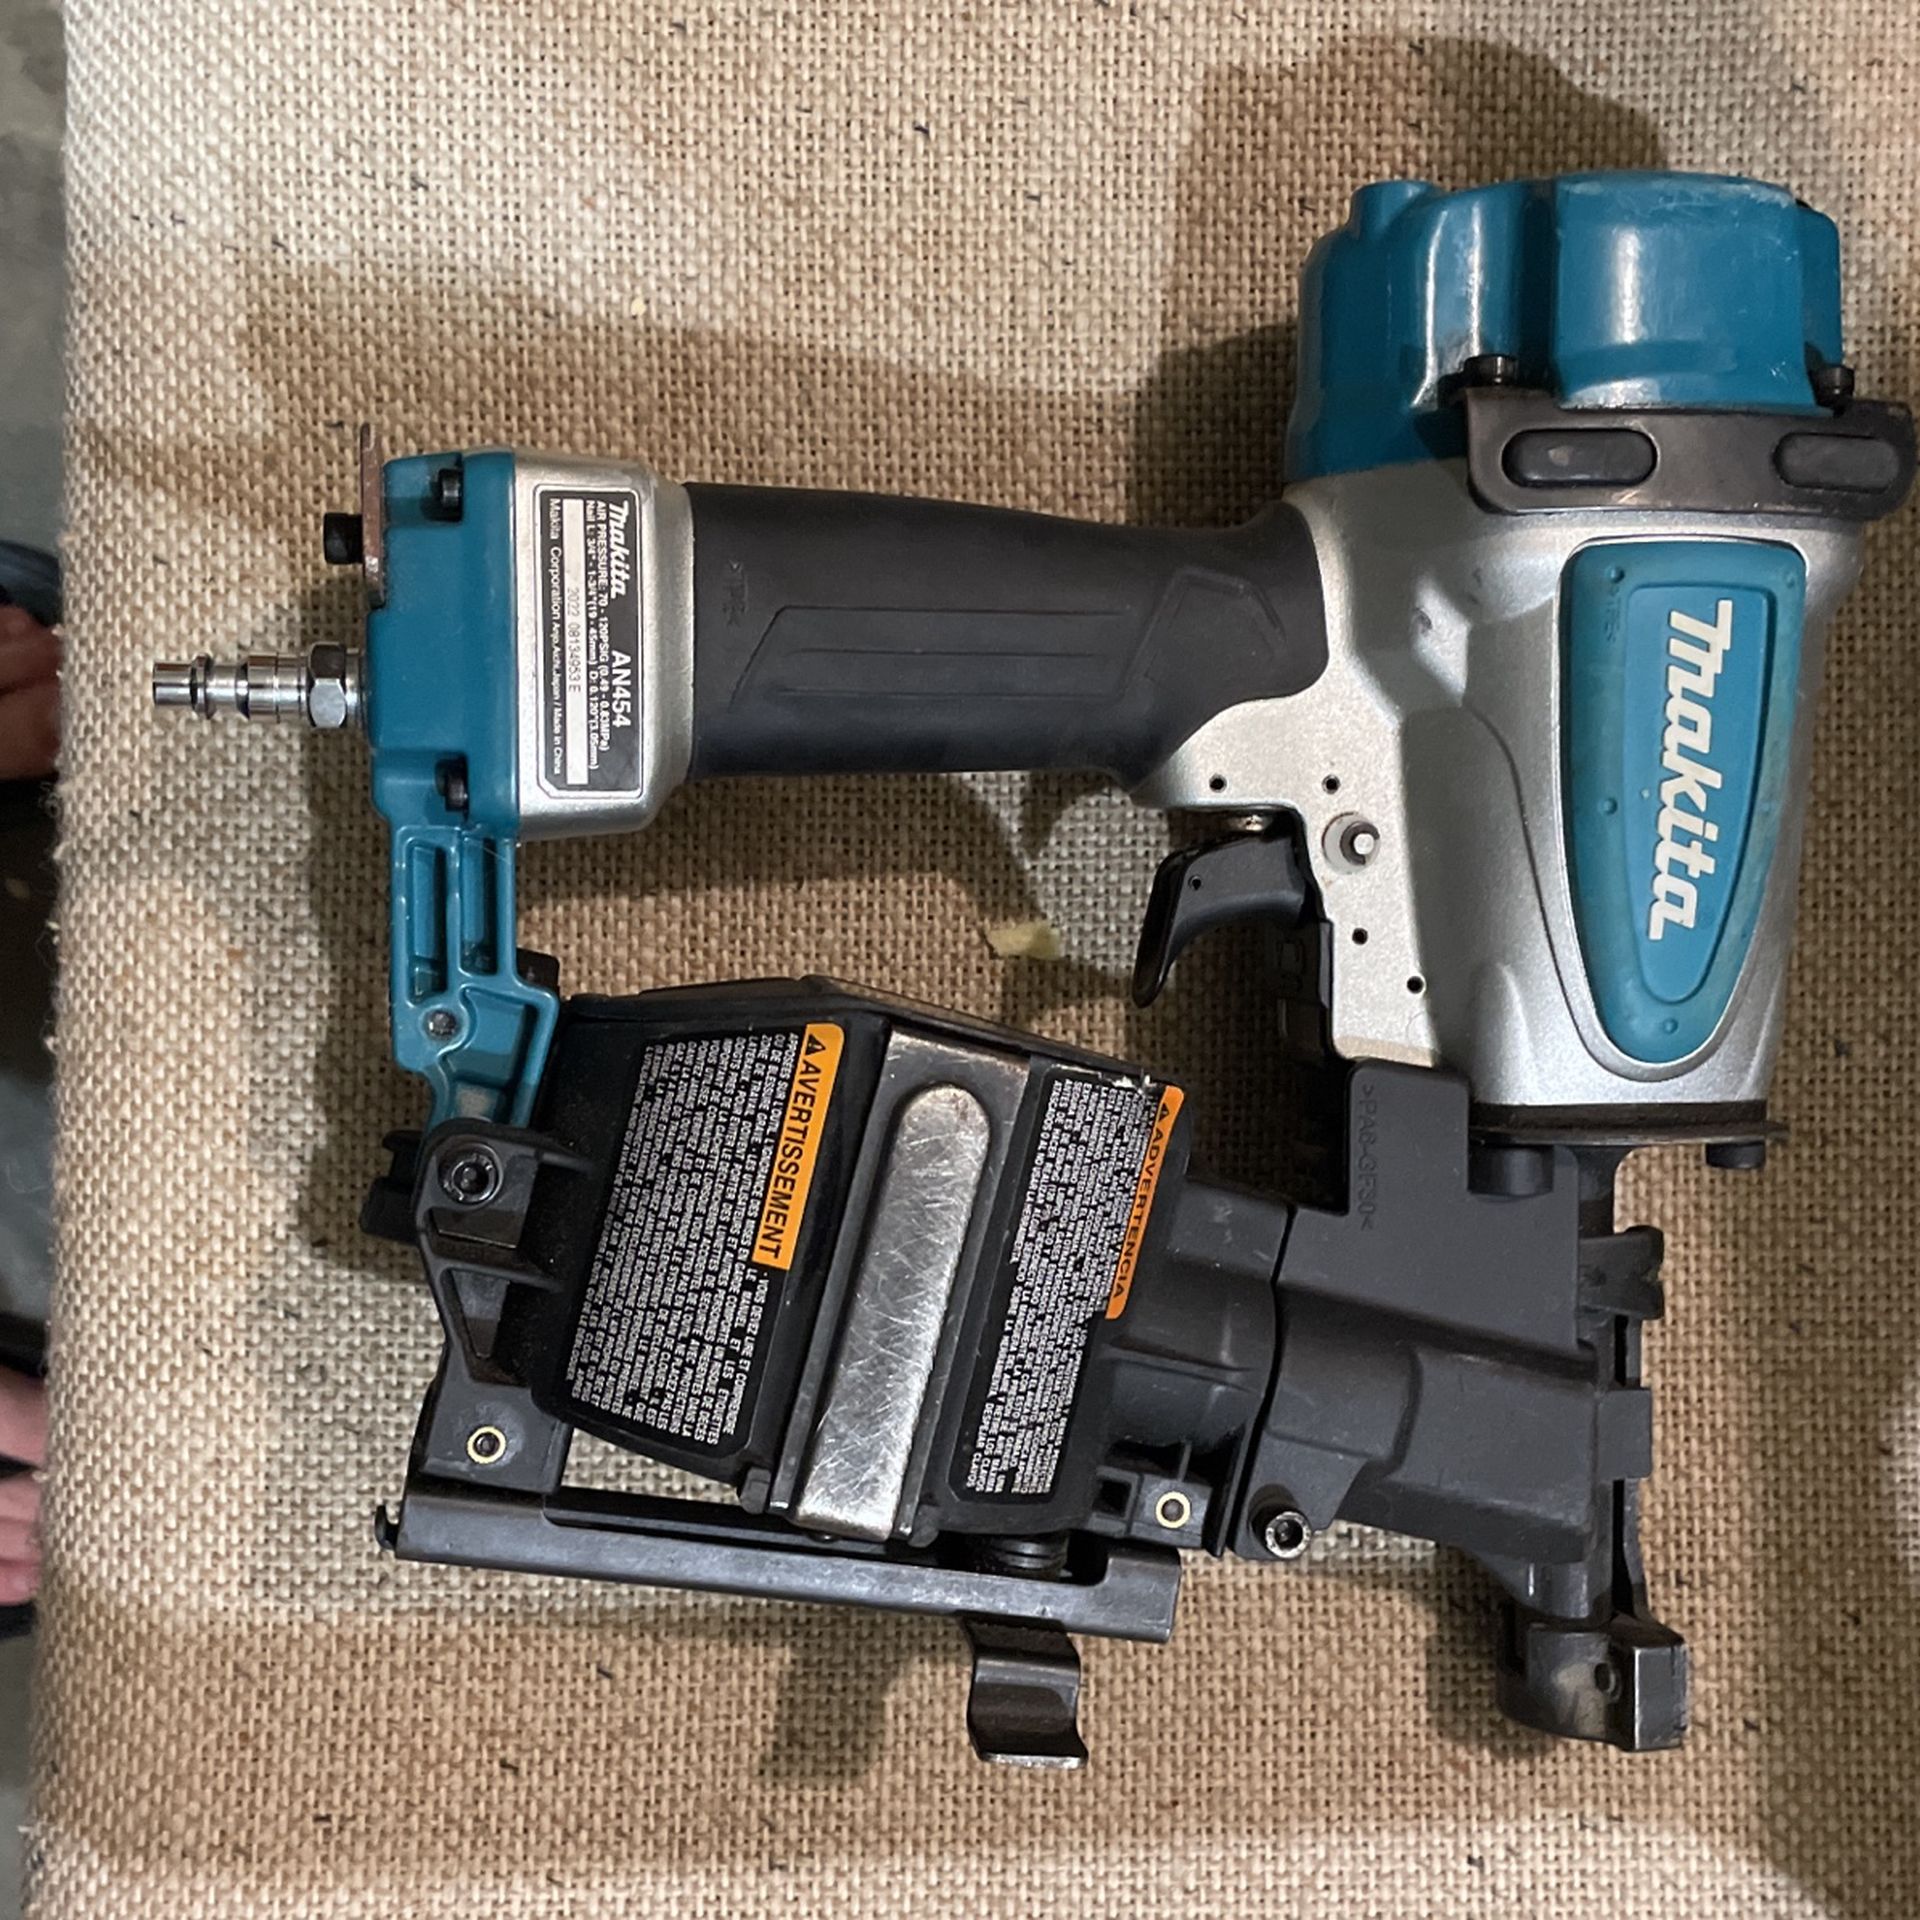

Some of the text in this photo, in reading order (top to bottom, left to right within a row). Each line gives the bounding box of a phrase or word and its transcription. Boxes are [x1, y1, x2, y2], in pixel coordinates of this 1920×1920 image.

[550, 498, 561, 540] Makita
[586, 500, 597, 522] Nail
[597, 500, 606, 520] AIR
[597, 523, 608, 590] PRESSURE:
[548, 546, 562, 620] Corporation
[567, 587, 580, 617] 2022
[598, 592, 608, 607] 70
[599, 616, 609, 662] 120PSIG
[612, 650, 632, 727] AN454
[553, 707, 563, 734] Made
[554, 736, 563, 745] in
[554, 747, 563, 775] China
[775, 1081, 787, 1099] SUR
[757, 1058, 823, 1258] AVERTISSEMENT
[747, 1199, 759, 1217] DES
[1113, 1127, 1164, 1299] ADVERTENCIA
[645, 1037, 745, 1425] DOIGTS DE LA LORSQUE VOUS PAS EN TRAIN DE IL EST
[669, 1035, 772, 1433] ZONE DE TRAVAIL DOIVENT PORTER DES LUNETTES DE AVEC PROTECTEURS
[681, 1034, 785, 1436] OU DE BLESSURE LES UTILISATEURS ET AUTRES PERSONNES DANS LA
[740, 1219, 755, 1245] MISES
[657, 1090, 746, 1429] POUR LE ACCIDENTEL NE PLACEZ PAS LES
[736, 1247, 748, 1260] EN
[729, 1262, 744, 1293] GARDE
[717, 1295, 737, 1343] COMPORTE
[722, 1268, 757, 1379] LE MANUEL ET LES
[713, 1345, 725, 1359] UN
[723, 1278, 768, 1433] VOUS DEVEZ LIRE ET COMPRENDRE
[705, 1361, 721, 1393] RISQUE
[701, 1395, 713, 1408] DE
